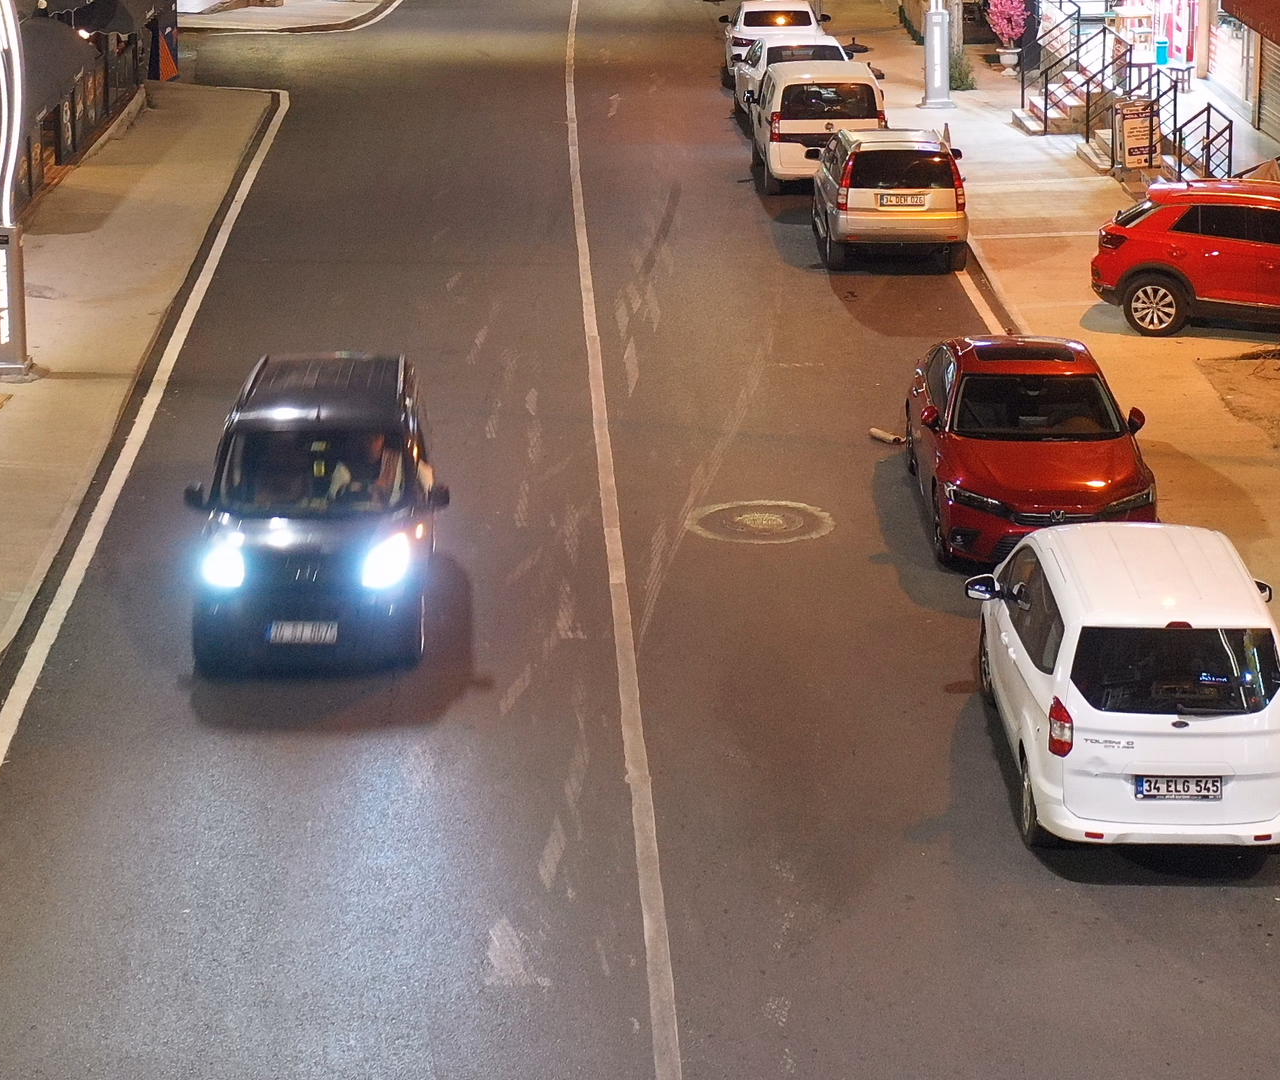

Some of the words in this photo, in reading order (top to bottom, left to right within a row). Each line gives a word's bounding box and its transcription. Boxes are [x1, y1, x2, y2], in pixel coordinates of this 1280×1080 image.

[884, 196, 893, 204] 34
[1144, 779, 1160, 793] 34
[1166, 779, 1190, 793] ELG
[1195, 779, 1220, 793] 545
